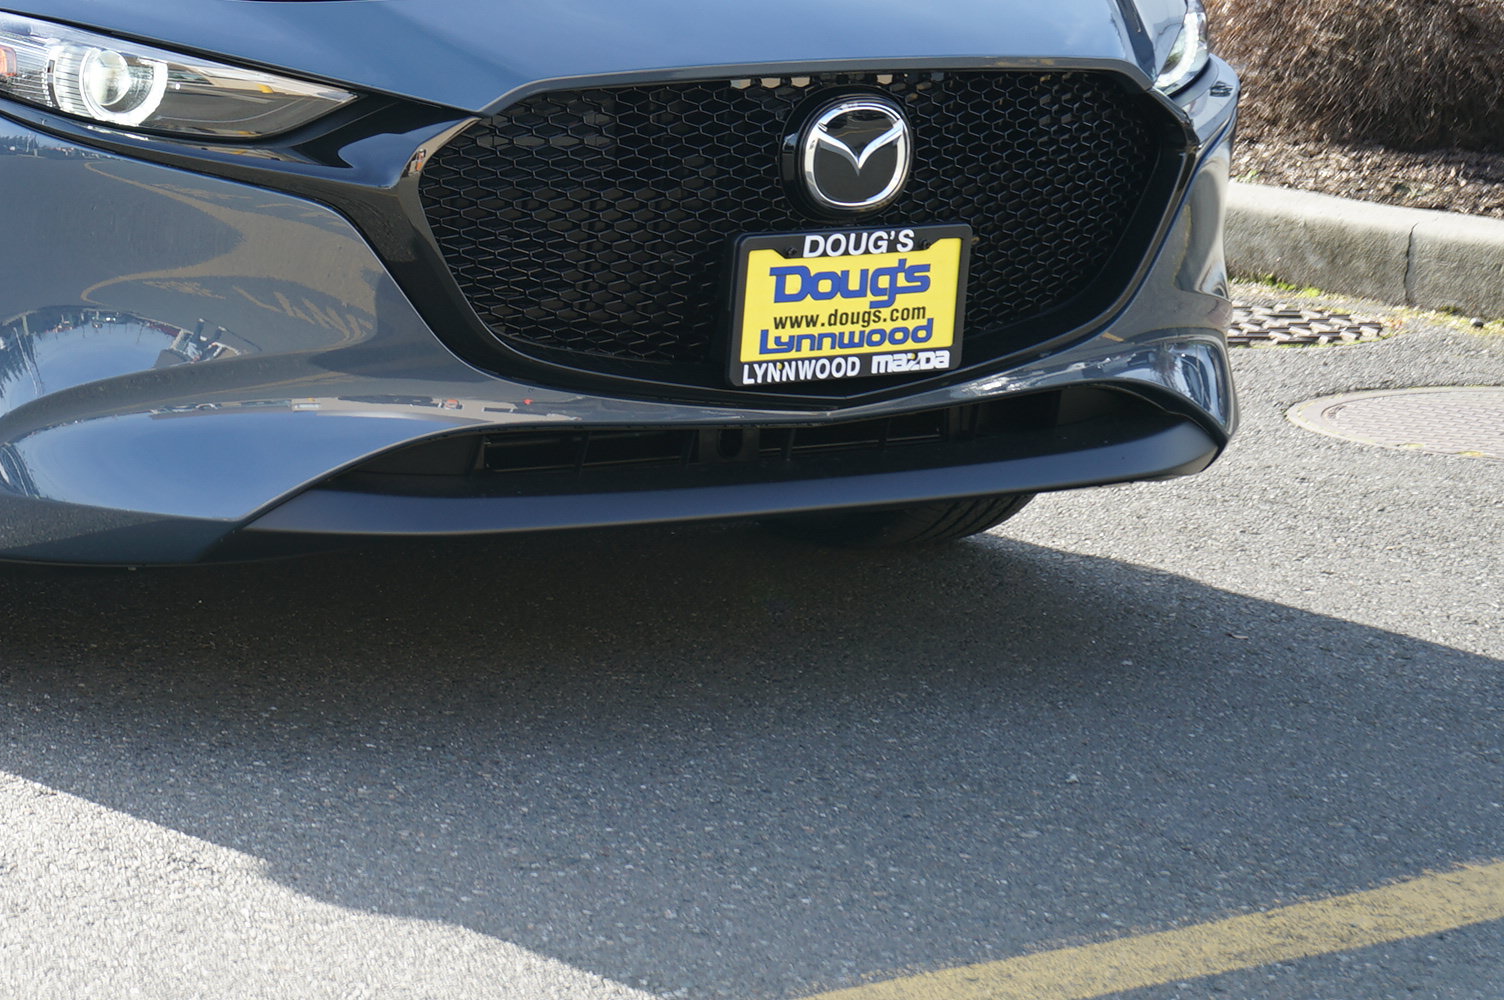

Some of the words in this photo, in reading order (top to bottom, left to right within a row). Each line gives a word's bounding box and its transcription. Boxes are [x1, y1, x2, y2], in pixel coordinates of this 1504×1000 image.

[802, 229, 915, 258] DOUG'S
[769, 258, 931, 310] Doug's
[773, 306, 927, 330] www.dougs.com
[759, 317, 934, 355] Lynnwood
[742, 356, 860, 385] LYNNWOOD
